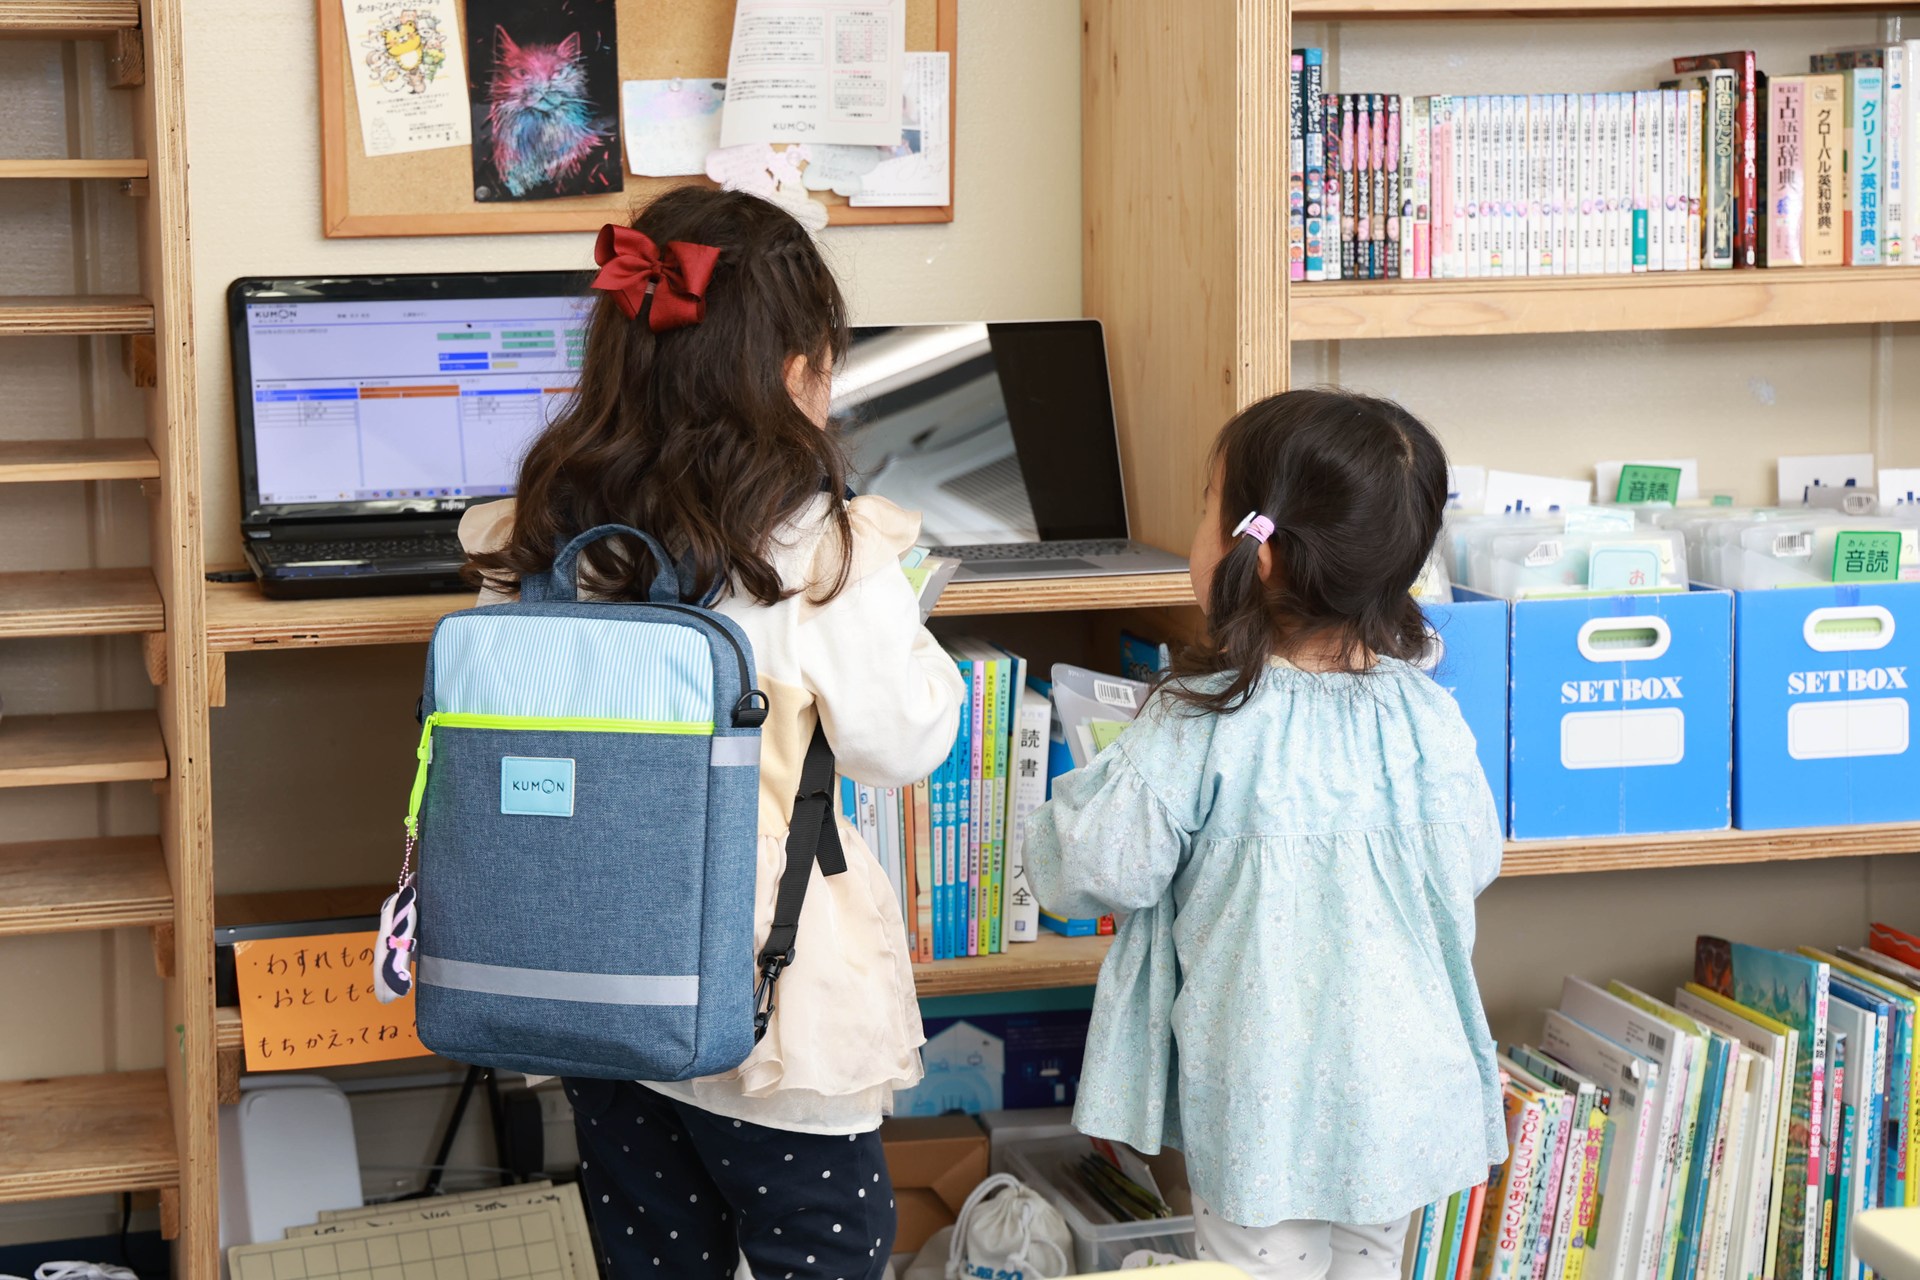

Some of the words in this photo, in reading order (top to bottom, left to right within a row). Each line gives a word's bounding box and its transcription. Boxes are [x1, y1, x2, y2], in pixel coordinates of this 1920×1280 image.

[773, 121, 816, 132] KUMON
[1716, 78, 1731, 157] 虹色ほたる
[1778, 96, 1799, 193] 古語辞典
[1817, 108, 1832, 230] グローバル英和辞典
[1860, 100, 1877, 246] グリーン英和辞典
[255, 309, 297, 320] KUMON
[1629, 481, 1669, 502] 音読
[1845, 550, 1889, 574] 音読
[1629, 569, 1645, 585] お
[512, 779, 565, 794] KUMON
[267, 947, 375, 977] わすれもの
